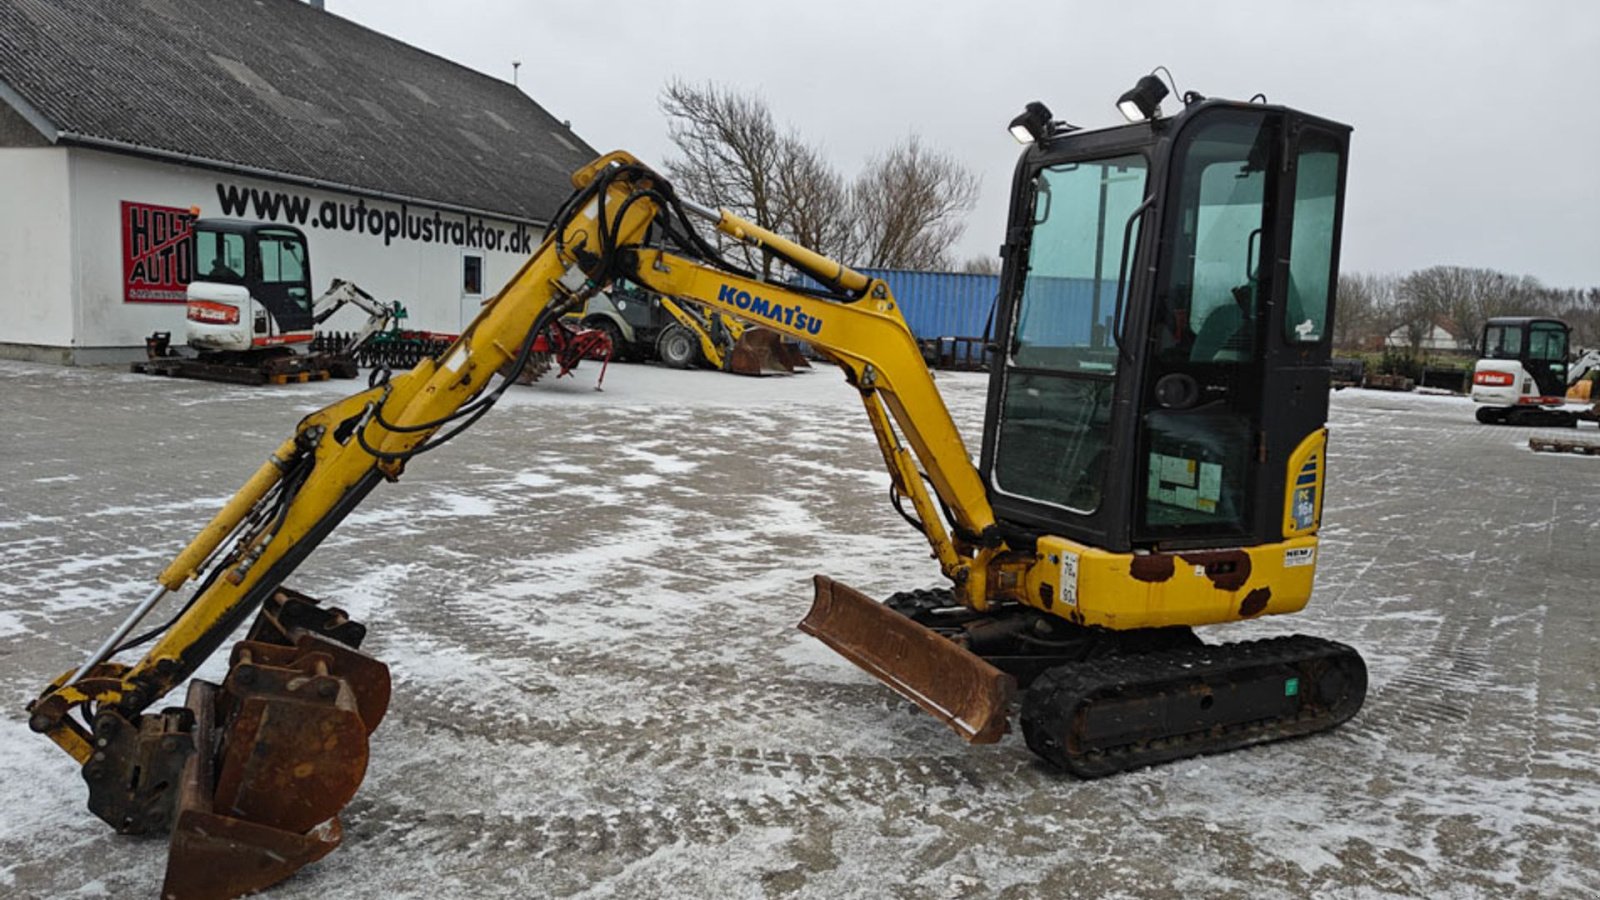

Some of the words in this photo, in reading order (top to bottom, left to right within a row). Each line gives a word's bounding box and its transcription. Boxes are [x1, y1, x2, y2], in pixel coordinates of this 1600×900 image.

[216, 183, 531, 254] www.autoplustraktor.dk
[129, 237, 192, 285] AUTO
[718, 283, 822, 335] KOMATSU
